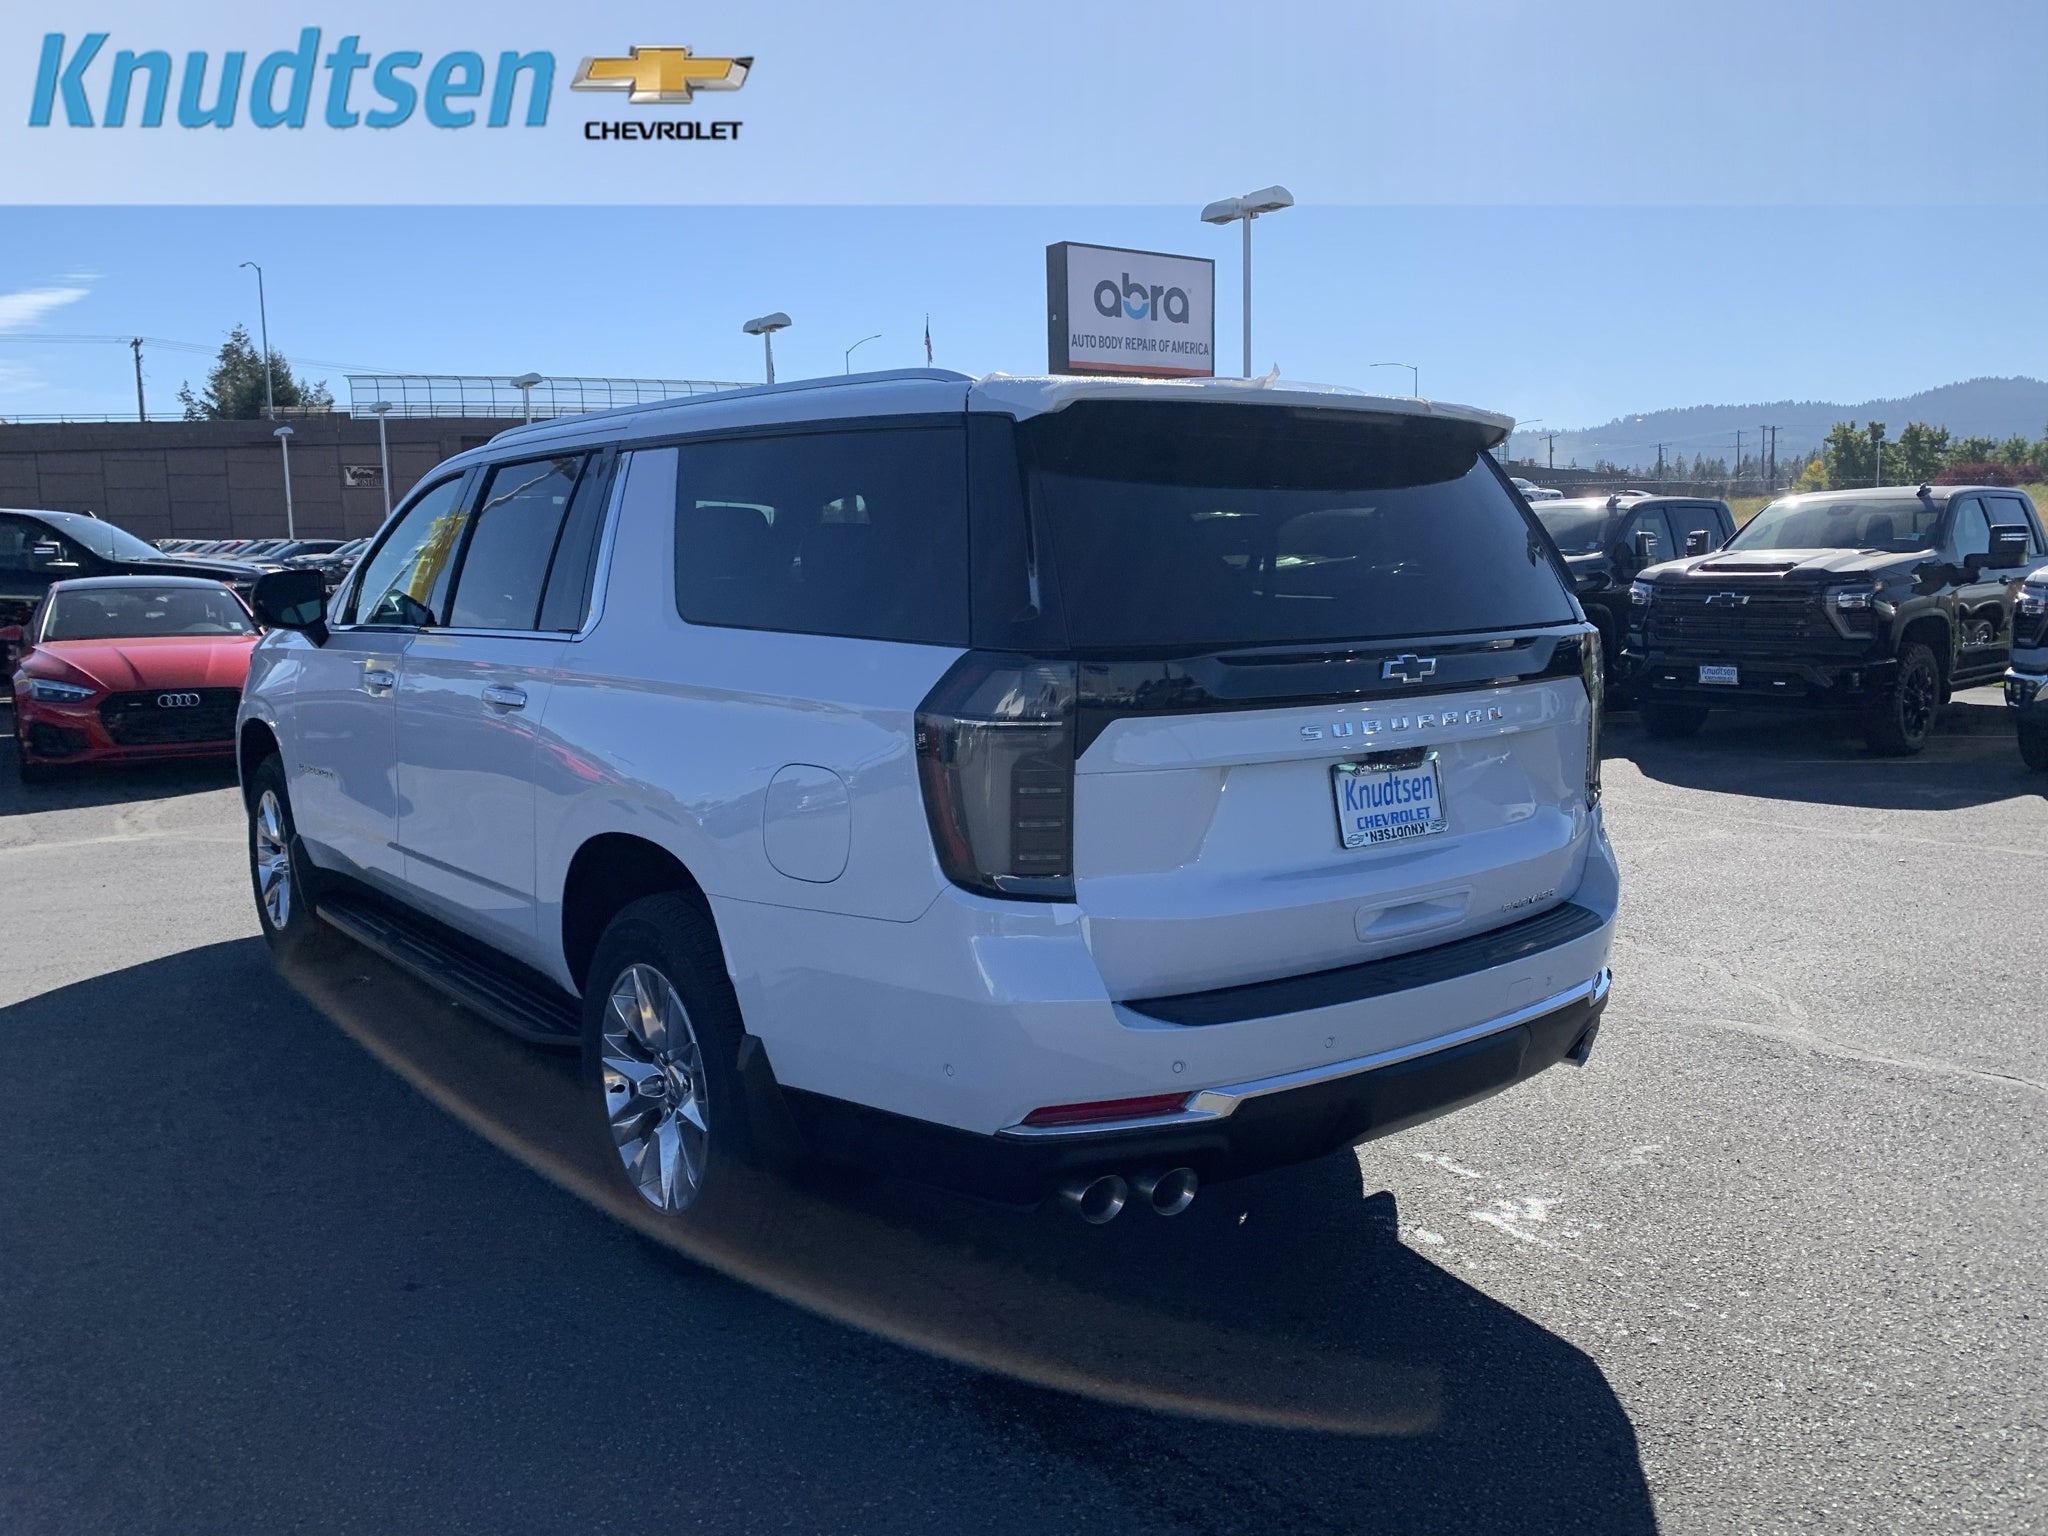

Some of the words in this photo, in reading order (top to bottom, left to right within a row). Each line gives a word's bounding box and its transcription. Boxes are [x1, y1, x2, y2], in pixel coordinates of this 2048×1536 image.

[1094, 272, 1189, 324] abra
[1071, 334, 1096, 348] AUTO
[1098, 335, 1124, 350] BODY
[1125, 337, 1156, 352] REPAIR
[1158, 339, 1170, 353] OF
[1171, 341, 1209, 356] AMERICA
[1702, 667, 1736, 676] Knudtsen
[1301, 706, 1503, 741] SUBURBAN
[1345, 773, 1433, 811] Knudtsen
[1357, 806, 1431, 830] CHEVROLET
